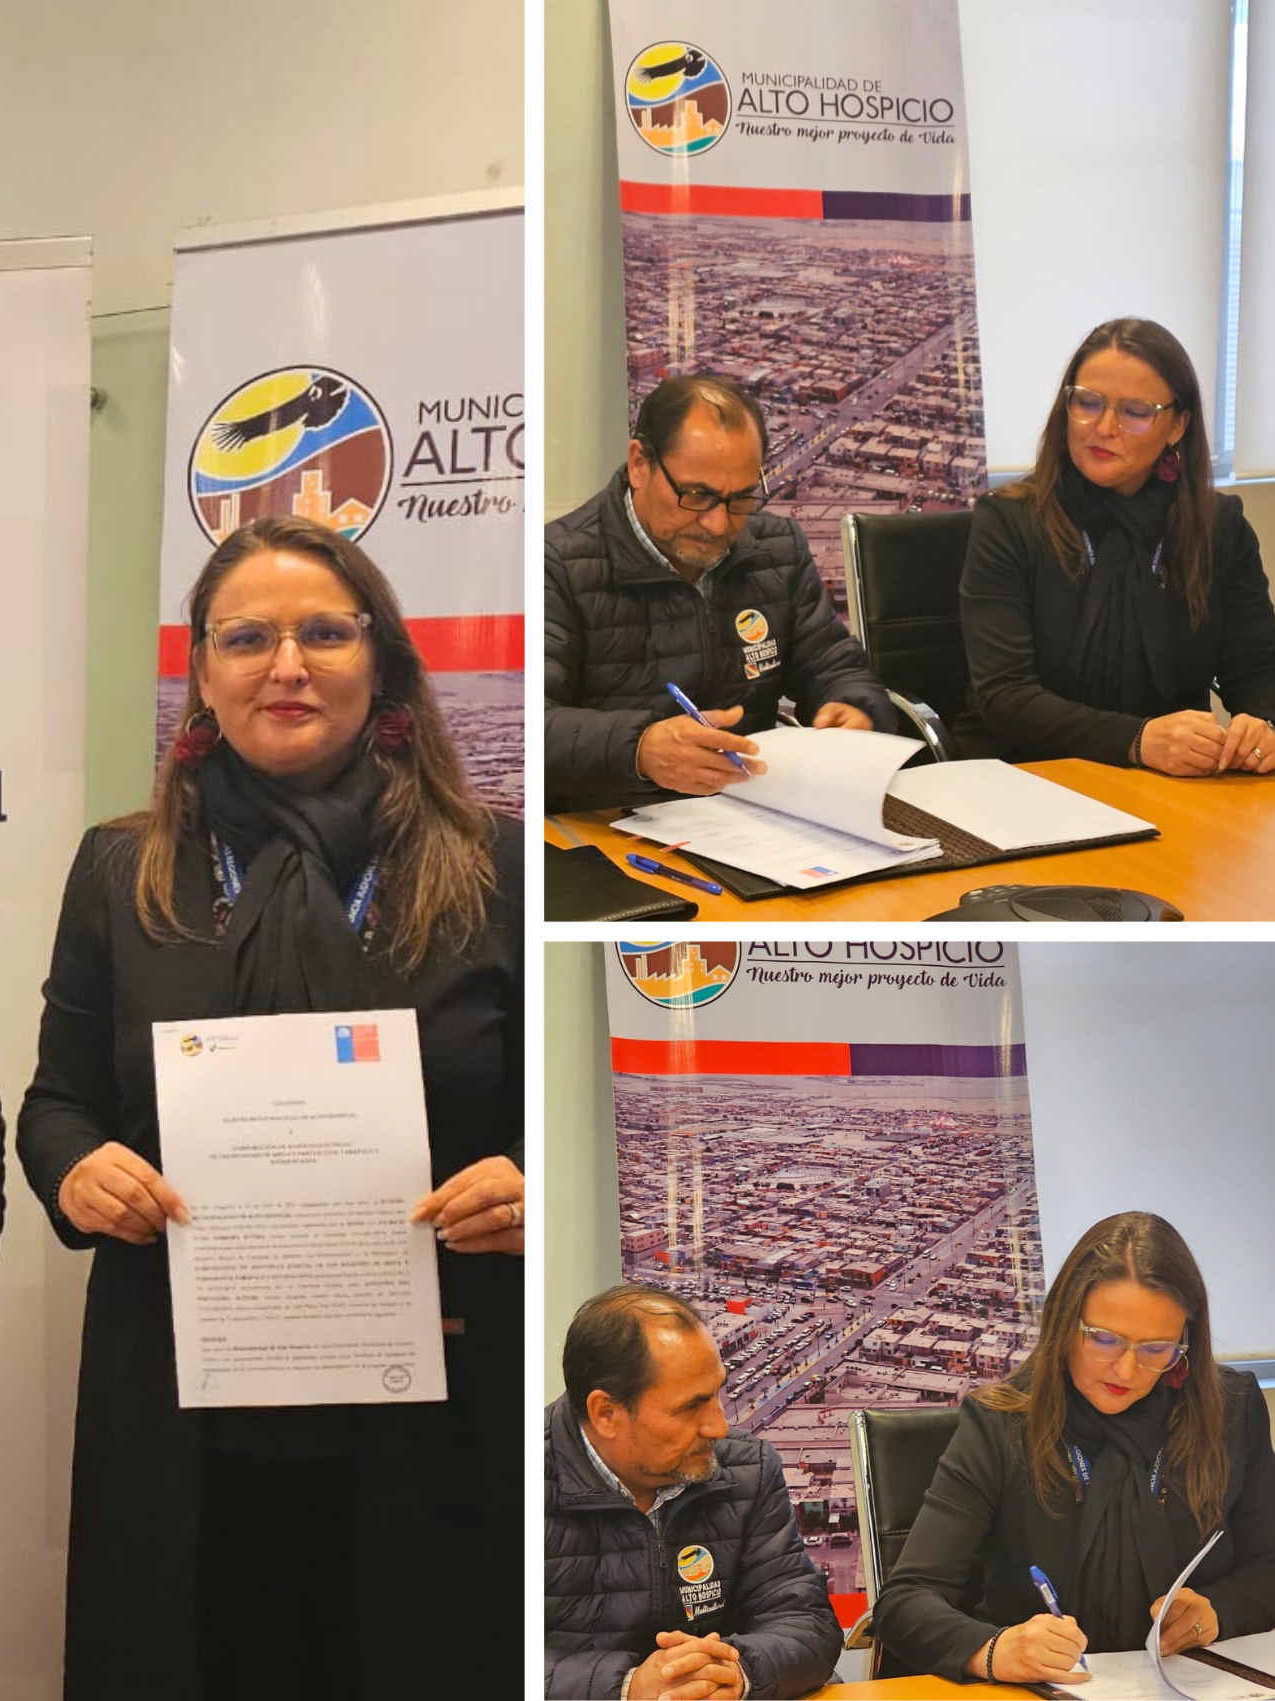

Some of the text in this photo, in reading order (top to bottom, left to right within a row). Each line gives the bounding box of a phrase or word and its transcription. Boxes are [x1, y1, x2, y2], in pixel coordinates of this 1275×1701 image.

[742, 72, 882, 93] MUNICIPALIDAD DE
[737, 88, 955, 123] ALTO HOSPICIO
[735, 121, 957, 145] Nuestro mejor proyecto de Vida
[419, 393, 524, 425] MUNIC
[397, 488, 517, 523] Nuestro
[746, 966, 1008, 989] Nuestro mejor proyecto de Vida
